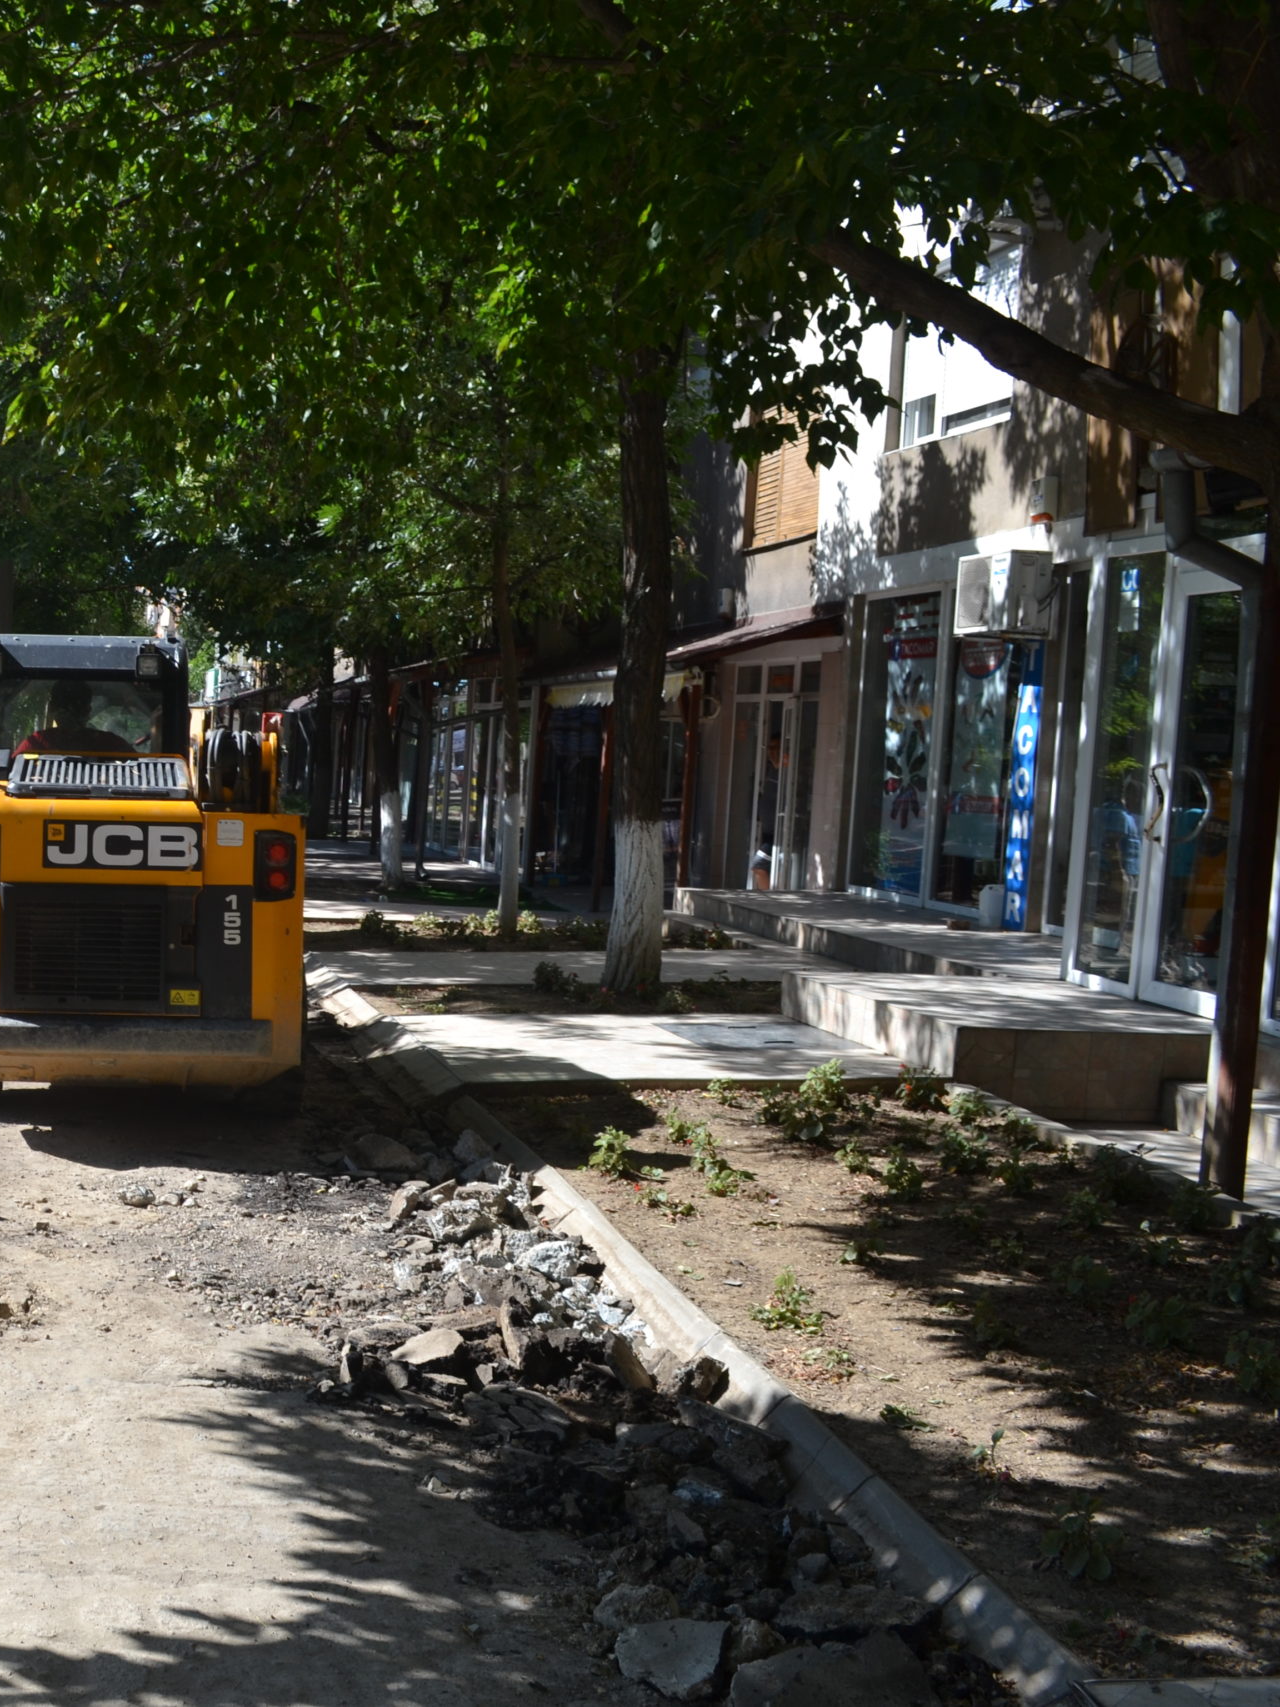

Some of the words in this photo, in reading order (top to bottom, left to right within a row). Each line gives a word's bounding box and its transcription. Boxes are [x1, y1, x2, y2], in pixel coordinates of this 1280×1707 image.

[1005, 642, 1040, 922] TACOMAR
[47, 824, 199, 867] JCB
[224, 894, 241, 945] 155
